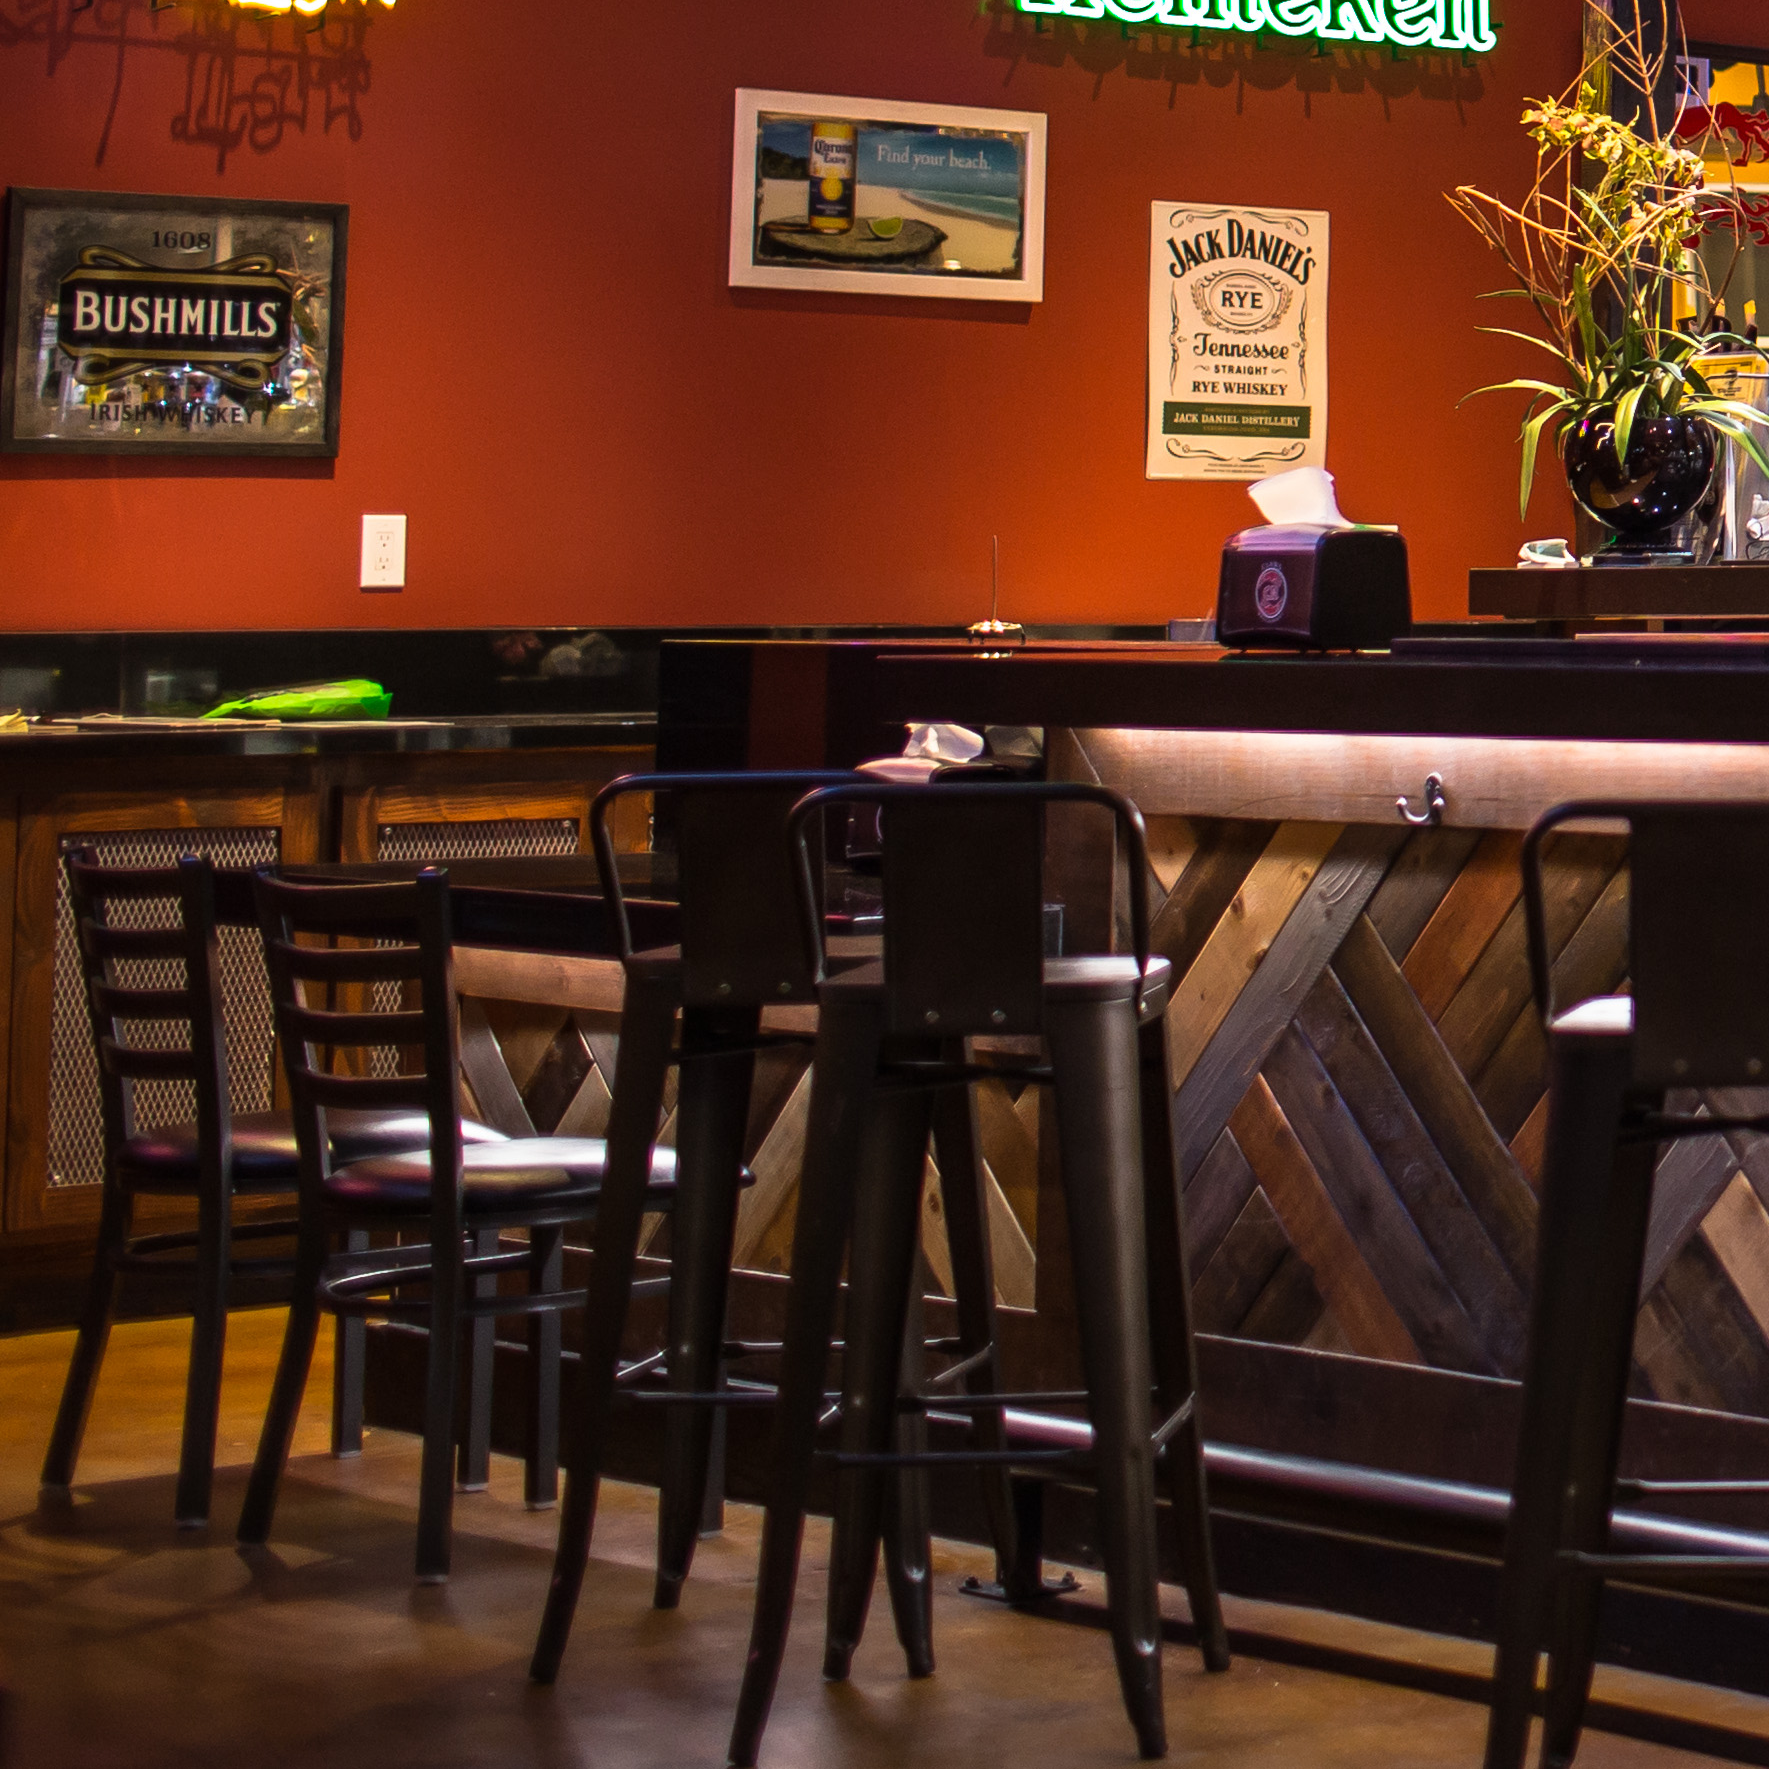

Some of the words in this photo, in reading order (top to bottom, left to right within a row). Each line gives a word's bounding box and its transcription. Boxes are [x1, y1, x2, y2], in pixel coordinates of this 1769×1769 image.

[877, 144, 910, 164] Find
[912, 149, 945, 170] your
[949, 148, 991, 171] beach.
[151, 230, 211, 250] 1608
[1166, 229, 1225, 278] JACK
[1227, 218, 1316, 285] DANIEL'S
[1221, 290, 1263, 309] RYE
[73, 290, 279, 338] BUSHMILLS
[1192, 332, 1290, 359] Tennessee
[1214, 364, 1268, 376] STRAIGHT
[1192, 381, 1220, 393] RYE
[1223, 382, 1288, 396] WHISKEY
[89, 402, 148, 422] IRISH
[152, 404, 255, 425] WHISKEY
[1173, 412, 1199, 424] JACK
[1201, 414, 1240, 425] DANIEL
[1242, 415, 1300, 428] DISTILLERY
